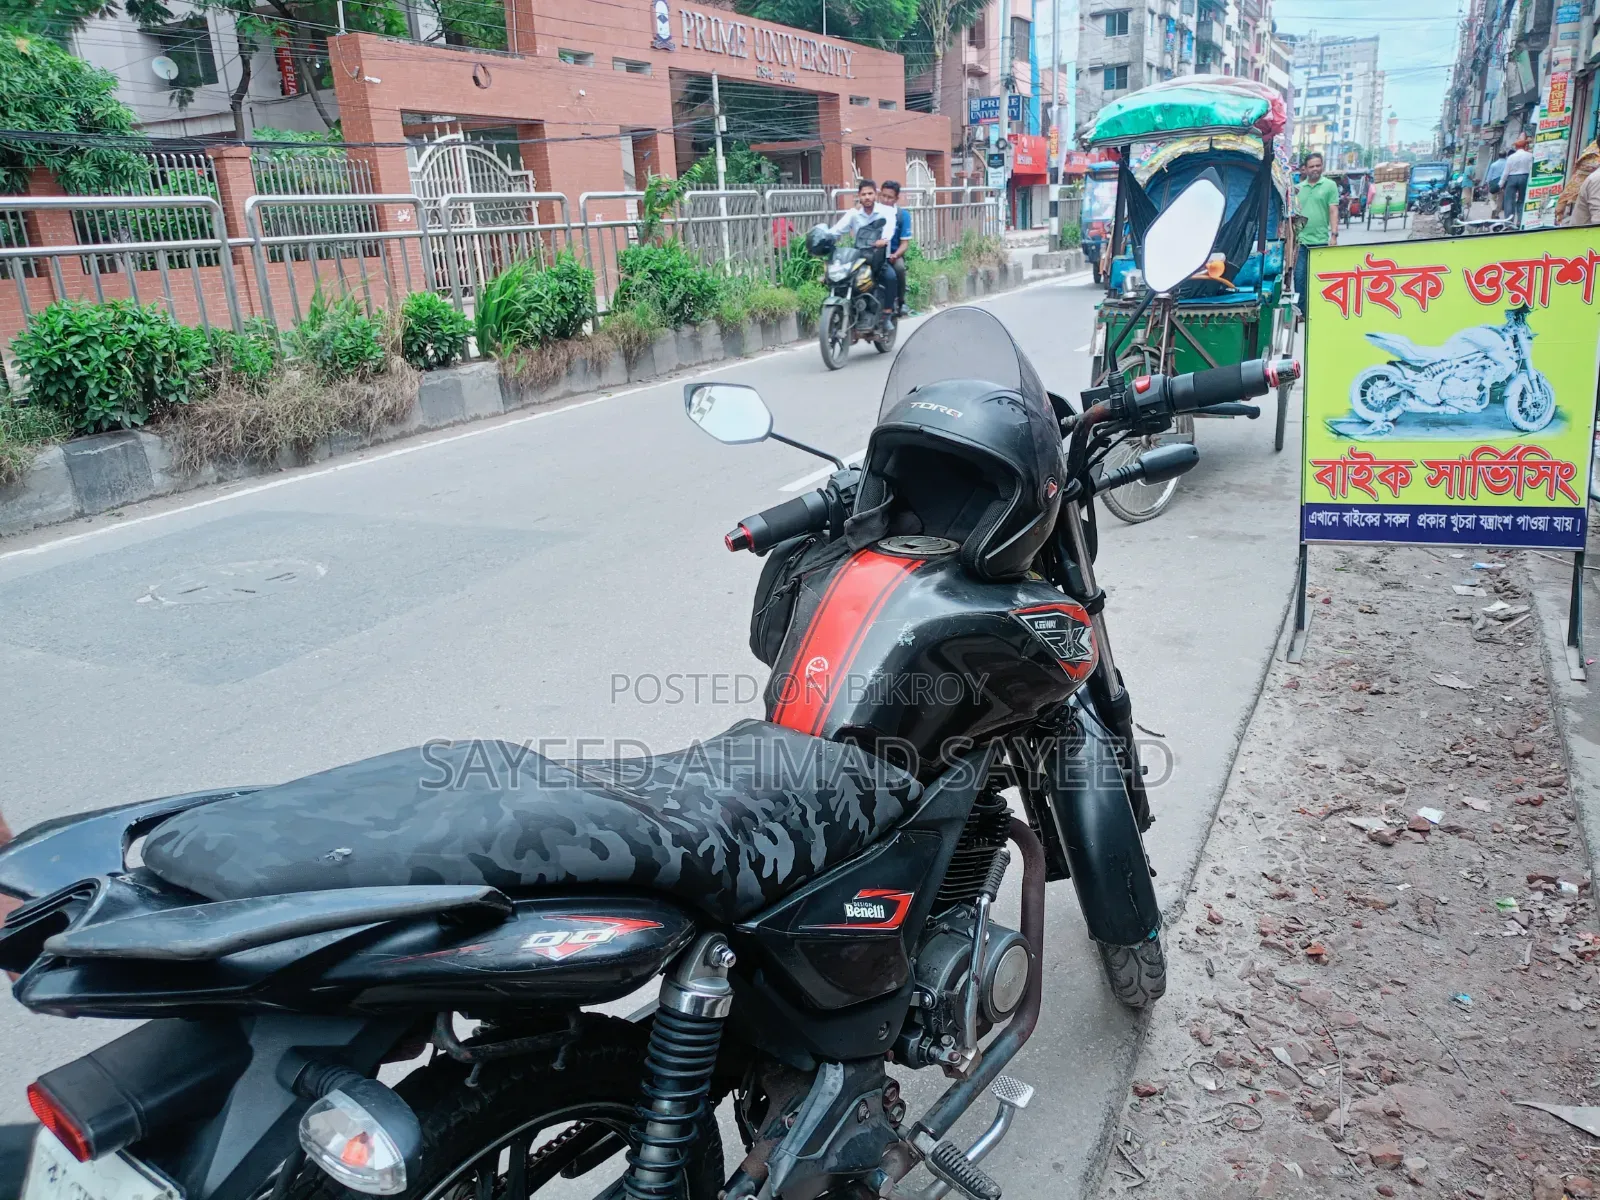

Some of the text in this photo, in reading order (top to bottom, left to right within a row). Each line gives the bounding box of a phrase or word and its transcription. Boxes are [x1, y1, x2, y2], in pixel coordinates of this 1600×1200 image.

[678, 8, 858, 79] PRIME UNIVERSITY
[981, 98, 1019, 109] PRIE
[970, 107, 1019, 120] UNIVERTY
[1316, 247, 1600, 319] বাইক ওয়াশ
[910, 401, 964, 419] TORQ
[1309, 443, 1580, 505] বাইক সার্ভিসিং
[1308, 510, 1340, 527] এখানে
[1342, 507, 1381, 528] বাইকের
[1383, 513, 1411, 528] সকল
[1416, 512, 1447, 529] প্রকার
[1450, 513, 1477, 533] খুচরা
[1516, 516, 1551, 532] পাওয়া
[1034, 620, 1057, 630] KEEWAY
[844, 903, 885, 918] Benelli
